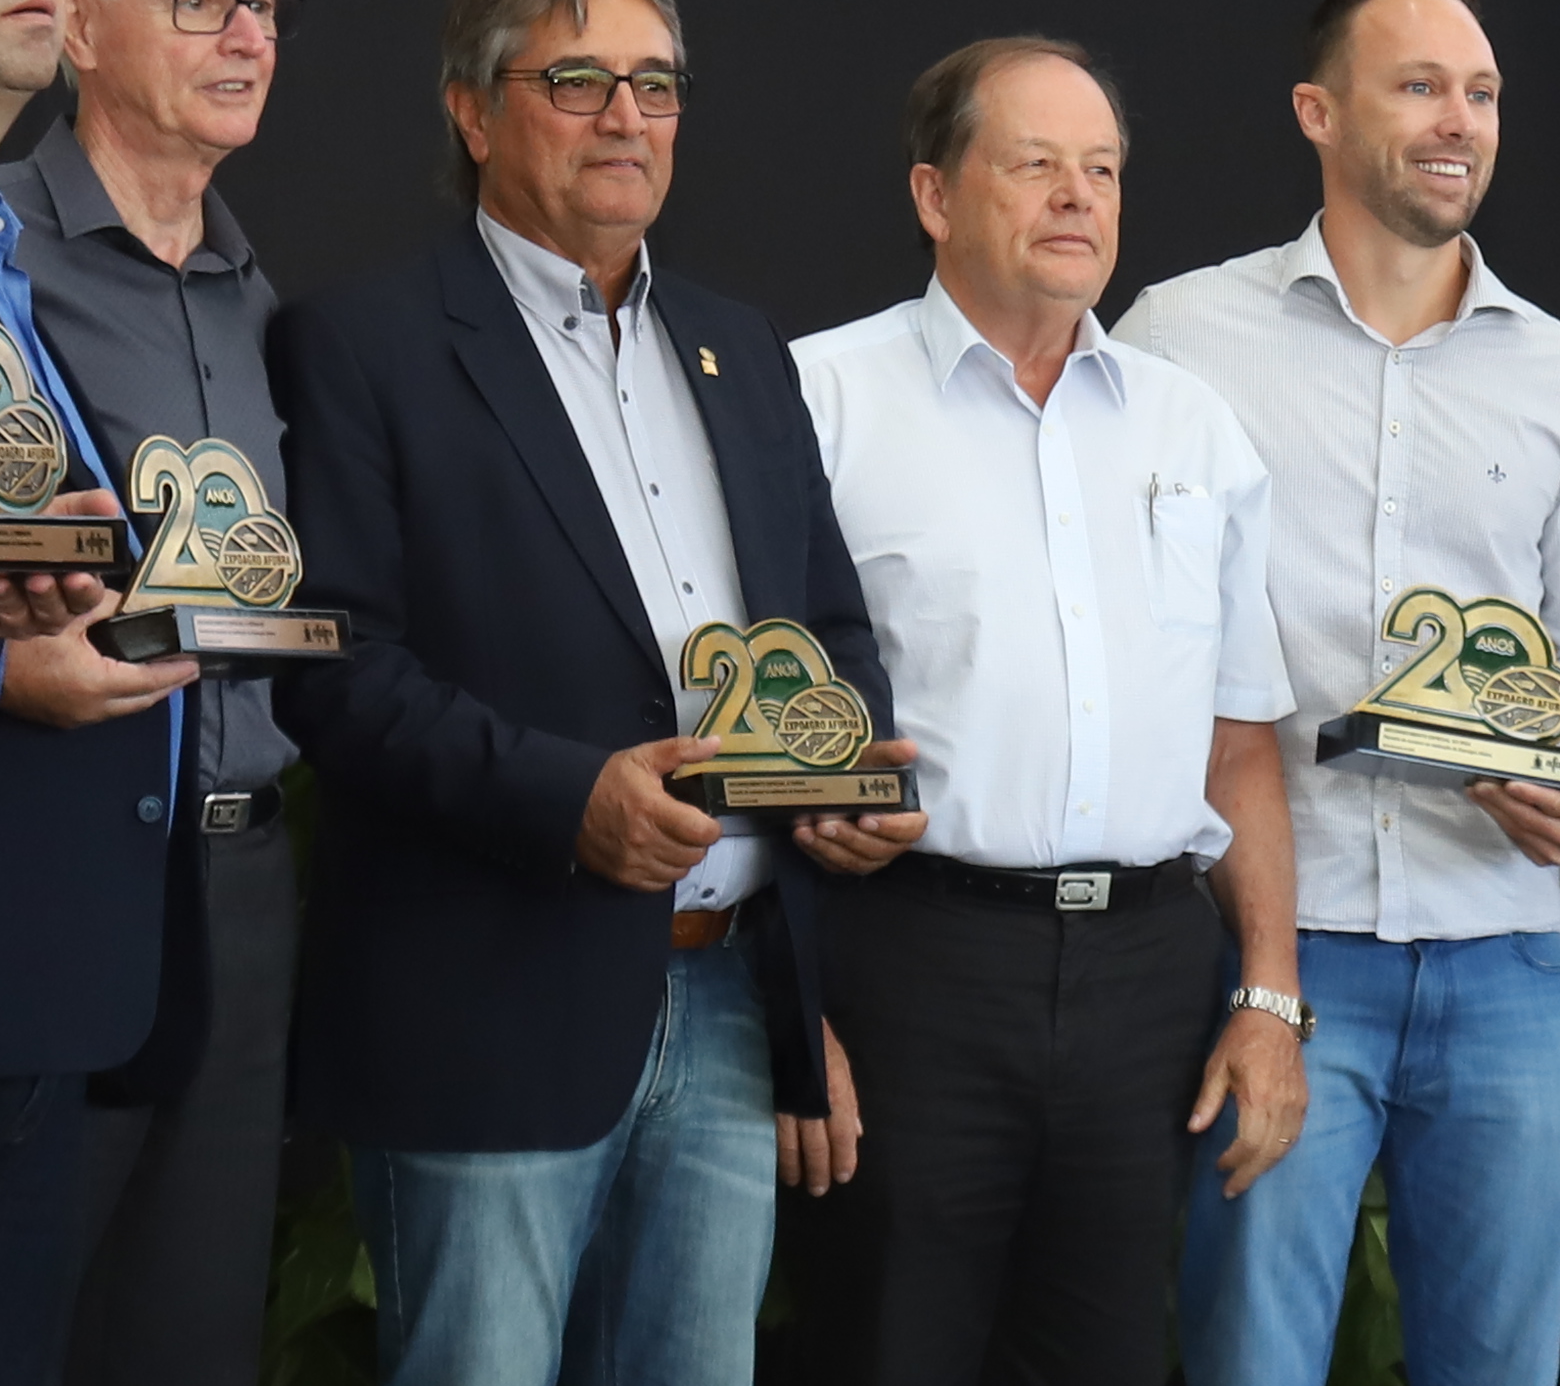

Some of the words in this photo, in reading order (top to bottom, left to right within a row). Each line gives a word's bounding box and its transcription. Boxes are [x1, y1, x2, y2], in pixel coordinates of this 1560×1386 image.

[135, 441, 266, 591] 20
[690, 625, 832, 755] 20
[1380, 592, 1548, 717] 20
[1475, 635, 1517, 657] ANOS
